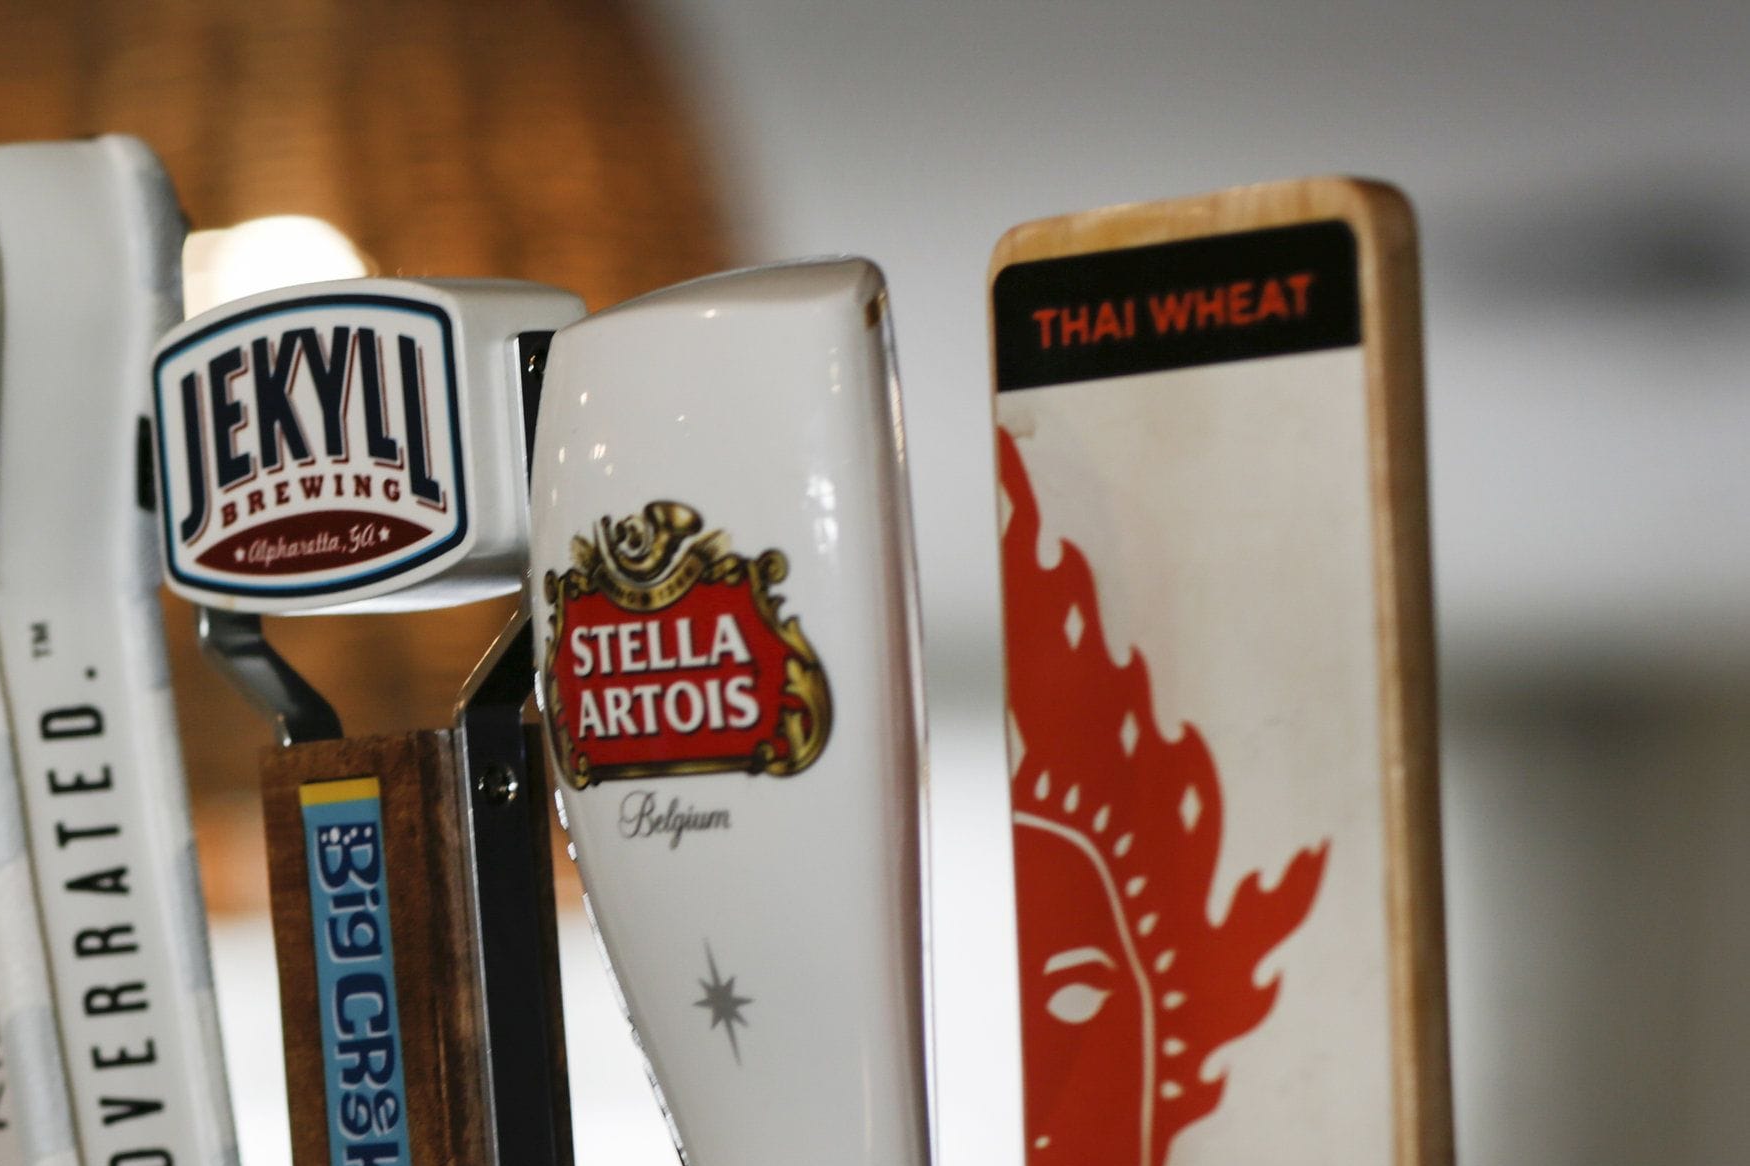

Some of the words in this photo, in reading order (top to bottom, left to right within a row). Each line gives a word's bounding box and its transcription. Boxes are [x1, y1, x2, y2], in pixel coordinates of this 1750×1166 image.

[1032, 300, 1136, 349] THAI
[1149, 273, 1316, 335] WHEAT
[181, 326, 447, 546] JEKYLL
[219, 475, 402, 528] BREWING
[570, 614, 752, 677] STELLA
[578, 676, 760, 738] ARTOIS
[618, 789, 732, 850] Belgium
